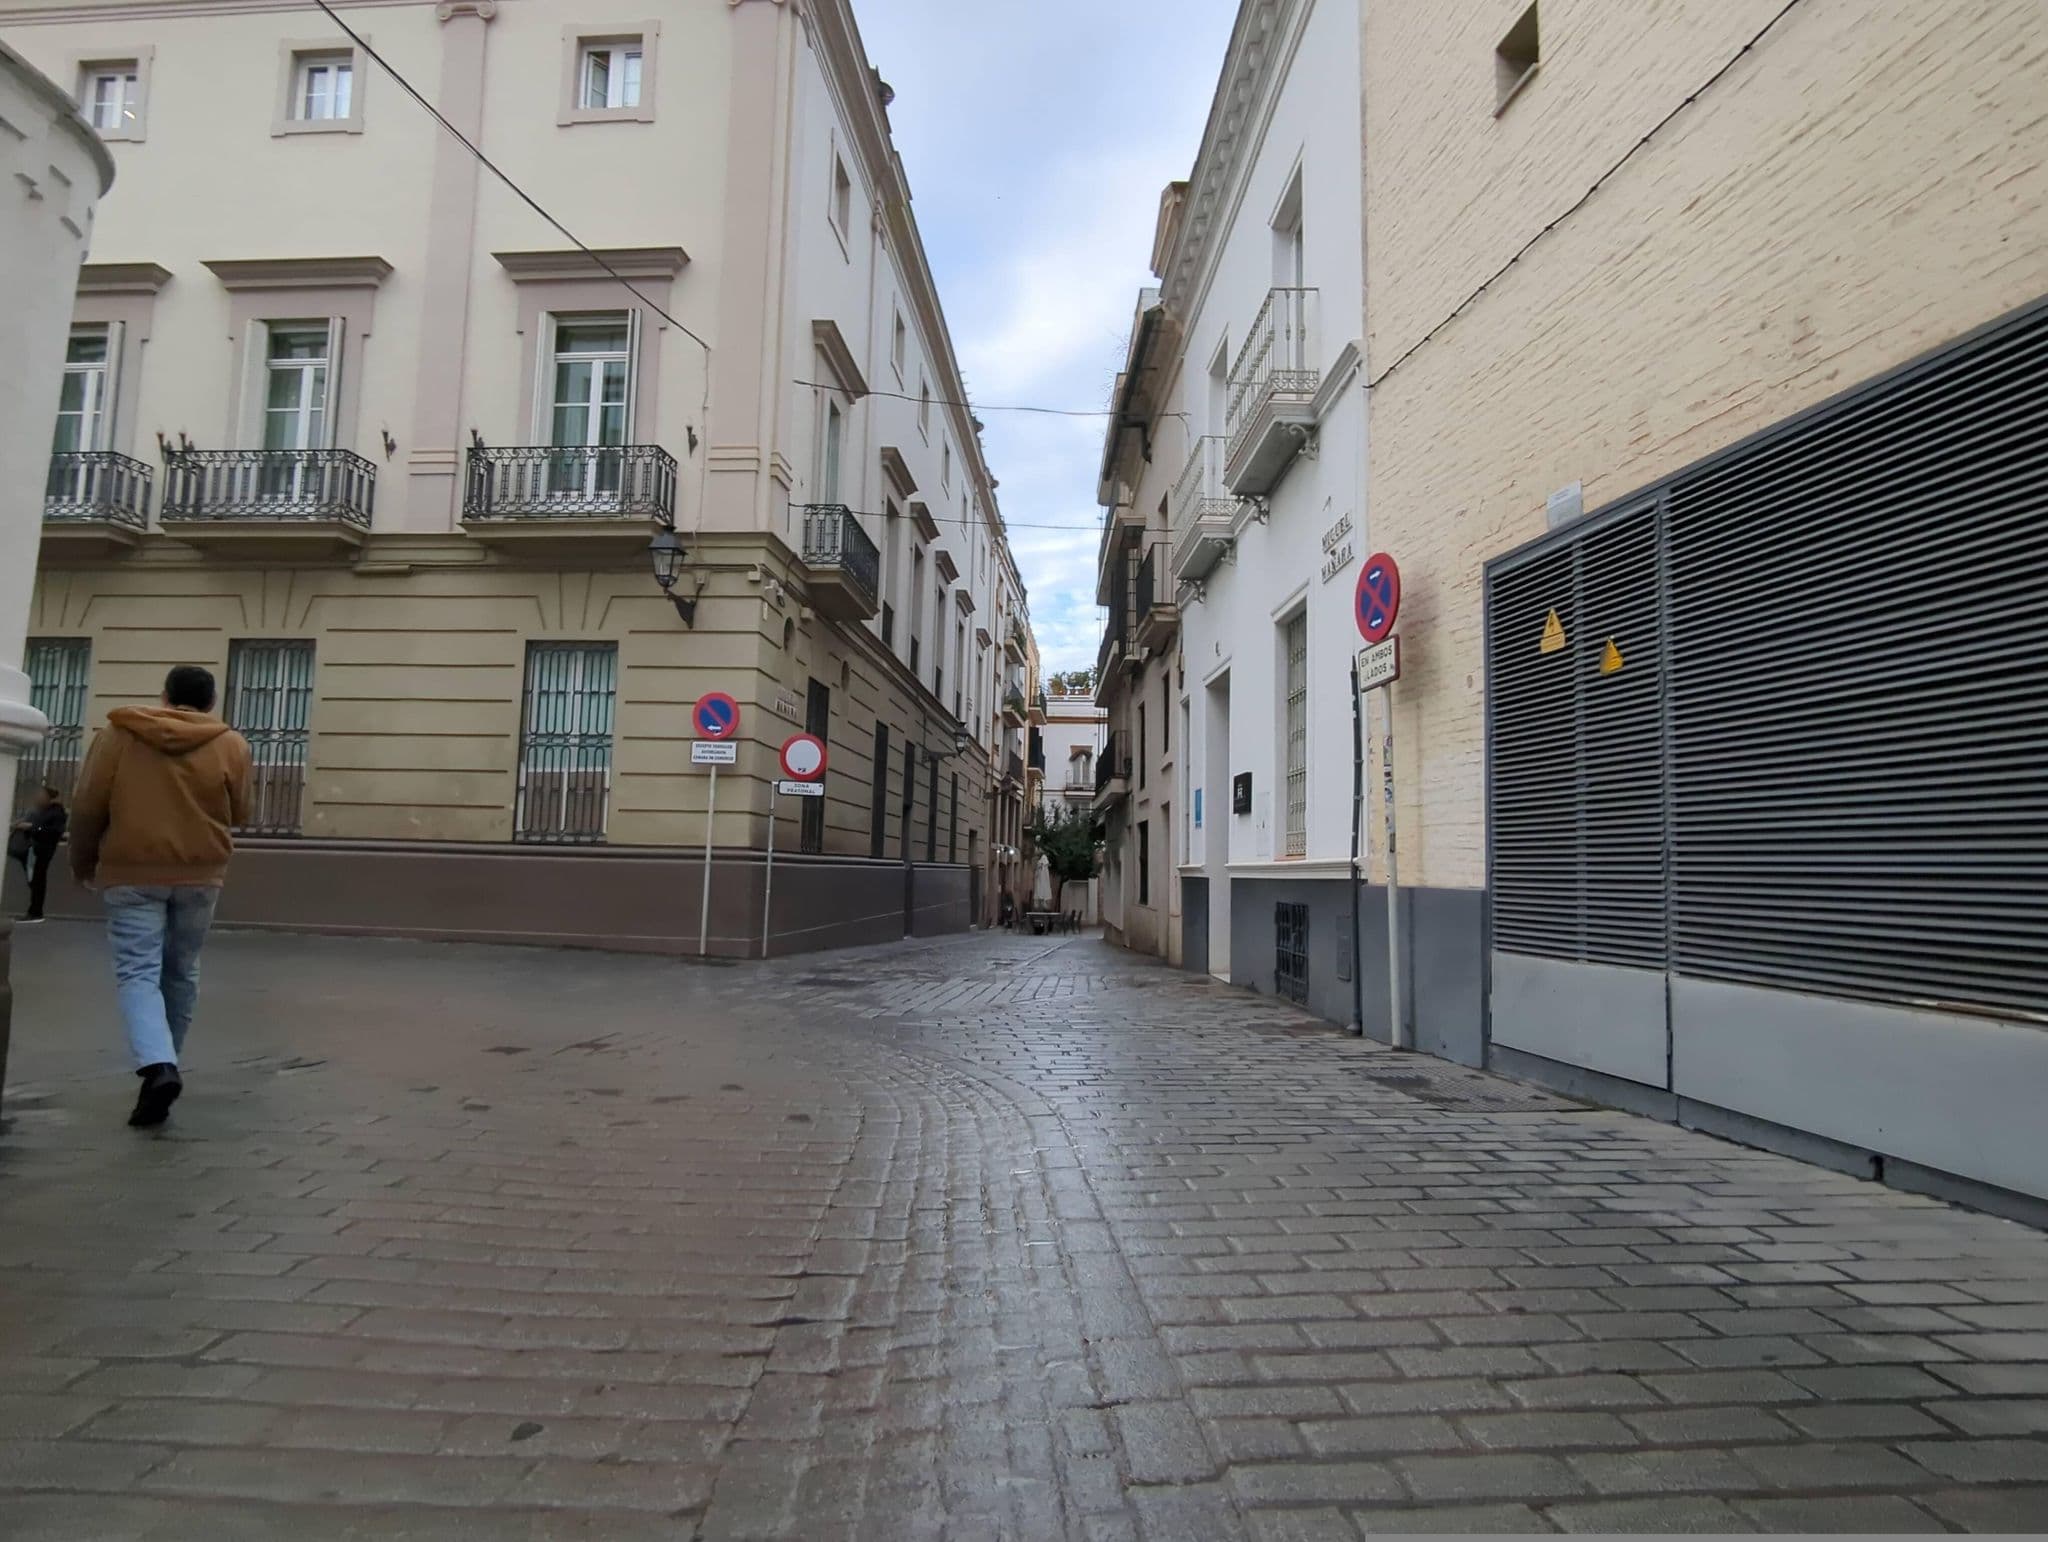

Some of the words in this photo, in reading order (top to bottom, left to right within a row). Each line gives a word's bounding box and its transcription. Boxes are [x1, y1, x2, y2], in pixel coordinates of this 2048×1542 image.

[1321, 512, 1351, 550] MIGUEL
[1371, 644, 1393, 662] AMBOS
[1367, 662, 1387, 680] LADOS
